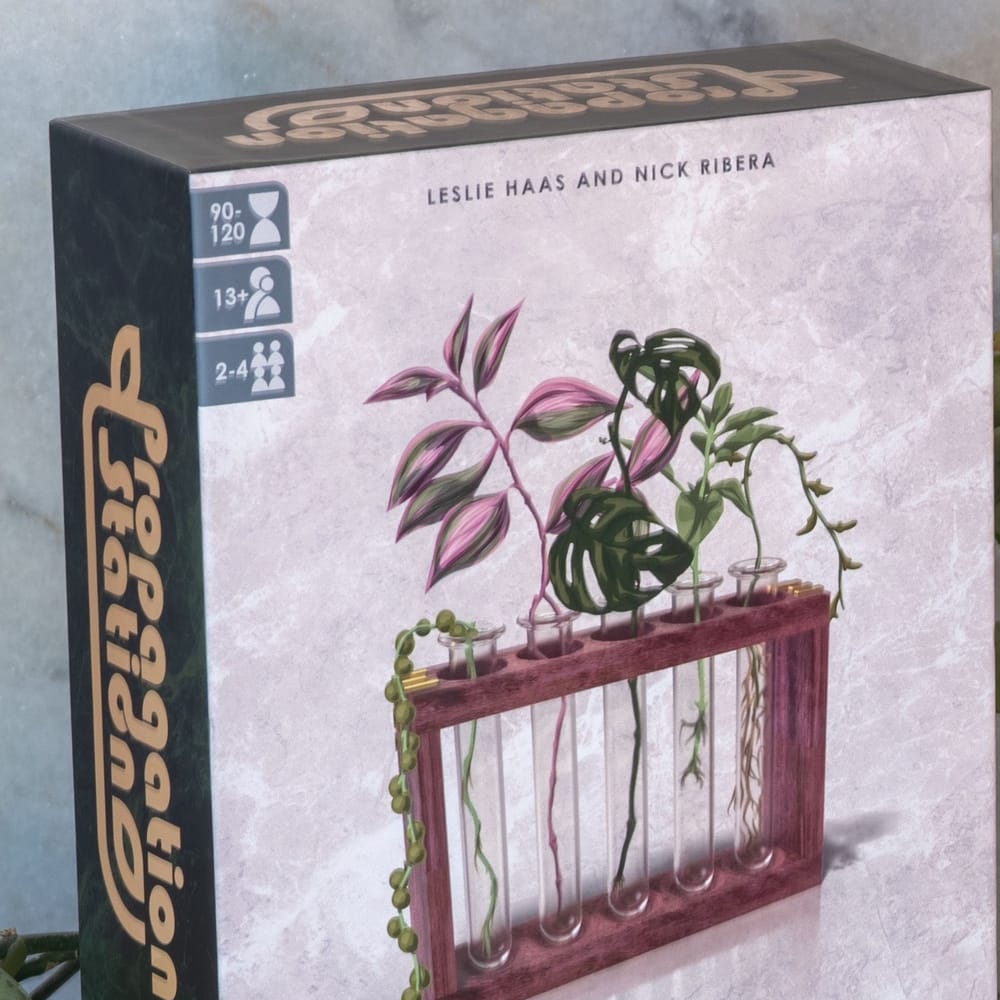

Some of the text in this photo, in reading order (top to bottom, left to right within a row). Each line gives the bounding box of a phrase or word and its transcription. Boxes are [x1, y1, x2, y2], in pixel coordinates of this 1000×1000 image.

[365, 71, 705, 114] Station
[225, 82, 799, 149] Propagation
[428, 152, 776, 205] LESLIE HAAS AND NICK RIBERA
[210, 202, 242, 221] 90-
[211, 222, 246, 243] 120
[214, 287, 248, 307] 13+
[215, 359, 248, 381] 2-4
[98, 426, 138, 794] Station
